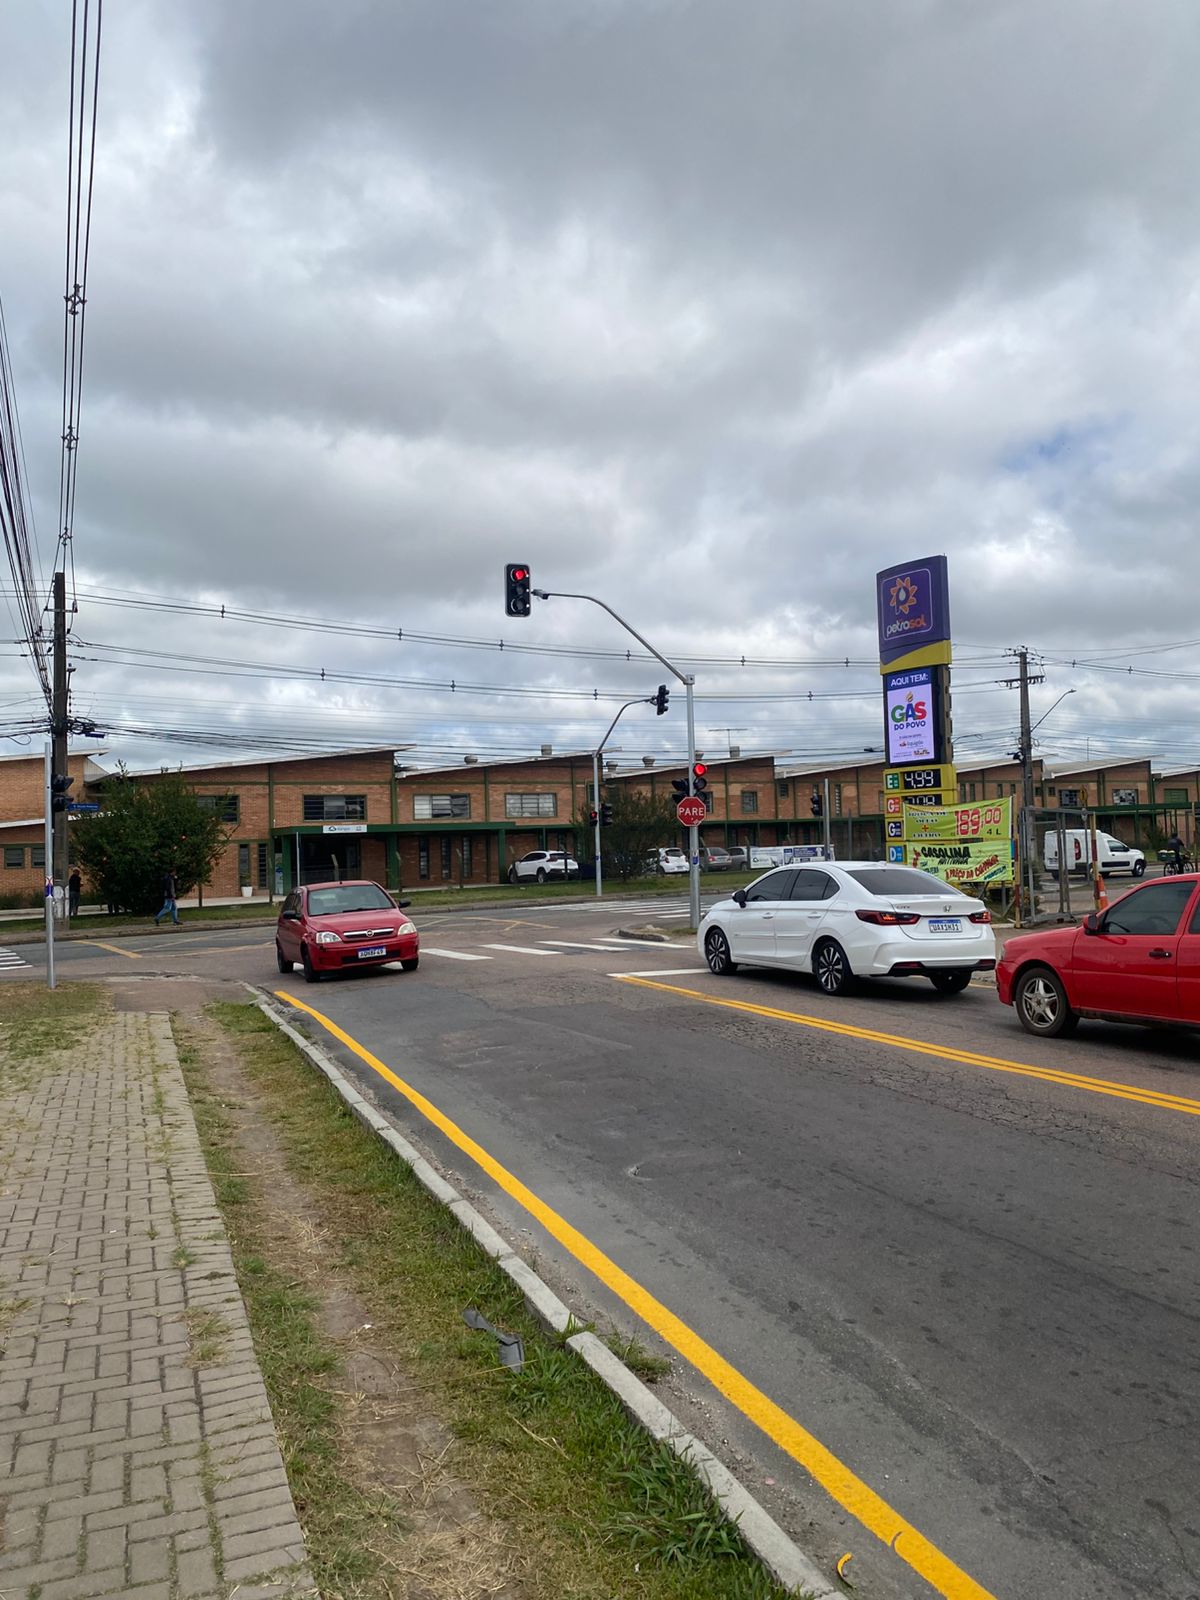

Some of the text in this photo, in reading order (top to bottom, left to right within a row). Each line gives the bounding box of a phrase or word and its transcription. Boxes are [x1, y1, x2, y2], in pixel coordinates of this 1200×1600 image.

[886, 614, 926, 638] petrosol
[890, 673, 928, 687] AQUI TEM:
[894, 720, 926, 731] DO POVO
[886, 774, 894, 789] E
[904, 770, 934, 789] 4,99
[679, 807, 704, 816] PARE
[887, 799, 895, 813] G
[954, 807, 1002, 836] 189,00
[888, 822, 896, 837] G
[986, 828, 1002, 836] 4 L
[889, 847, 897, 861] D
[921, 846, 971, 859] GASOLINA
